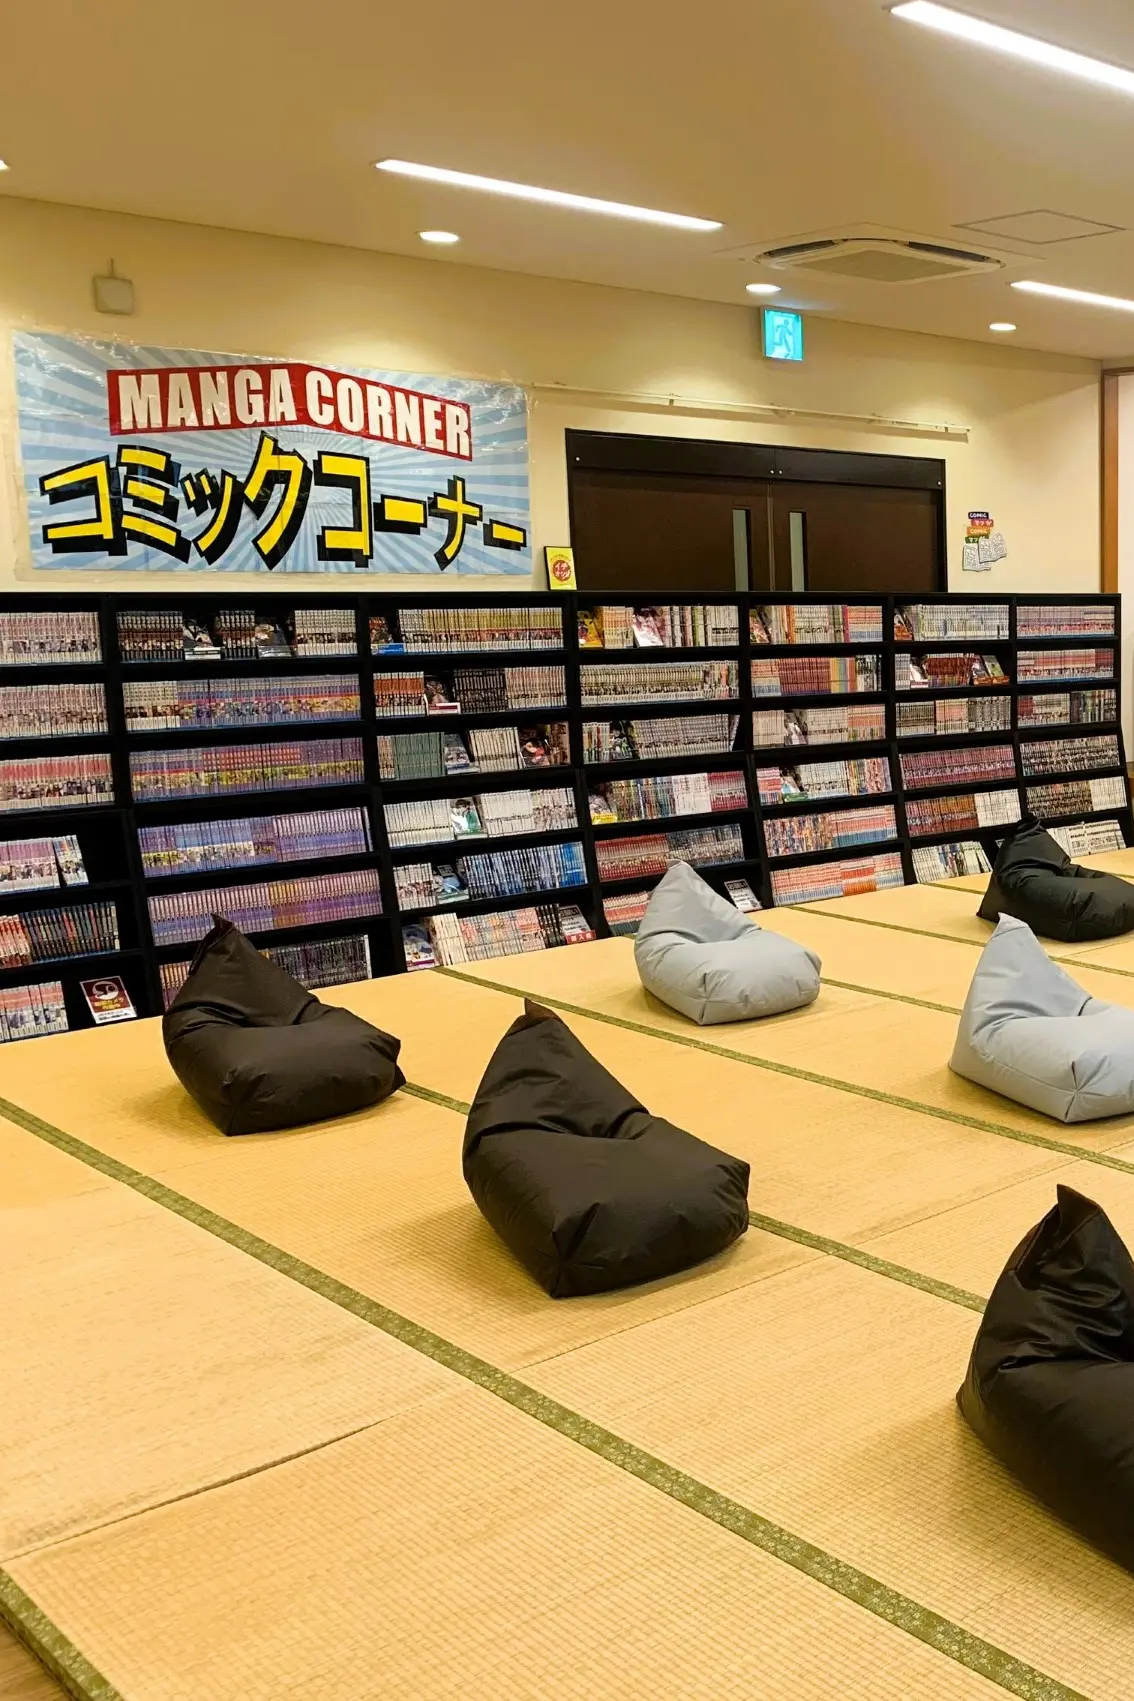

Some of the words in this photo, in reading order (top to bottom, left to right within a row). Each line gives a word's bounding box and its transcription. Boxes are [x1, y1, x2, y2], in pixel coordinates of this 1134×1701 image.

[117, 369, 297, 430] MANGA
[305, 372, 471, 456] CORNER
[39, 431, 526, 570] コミックコーナー
